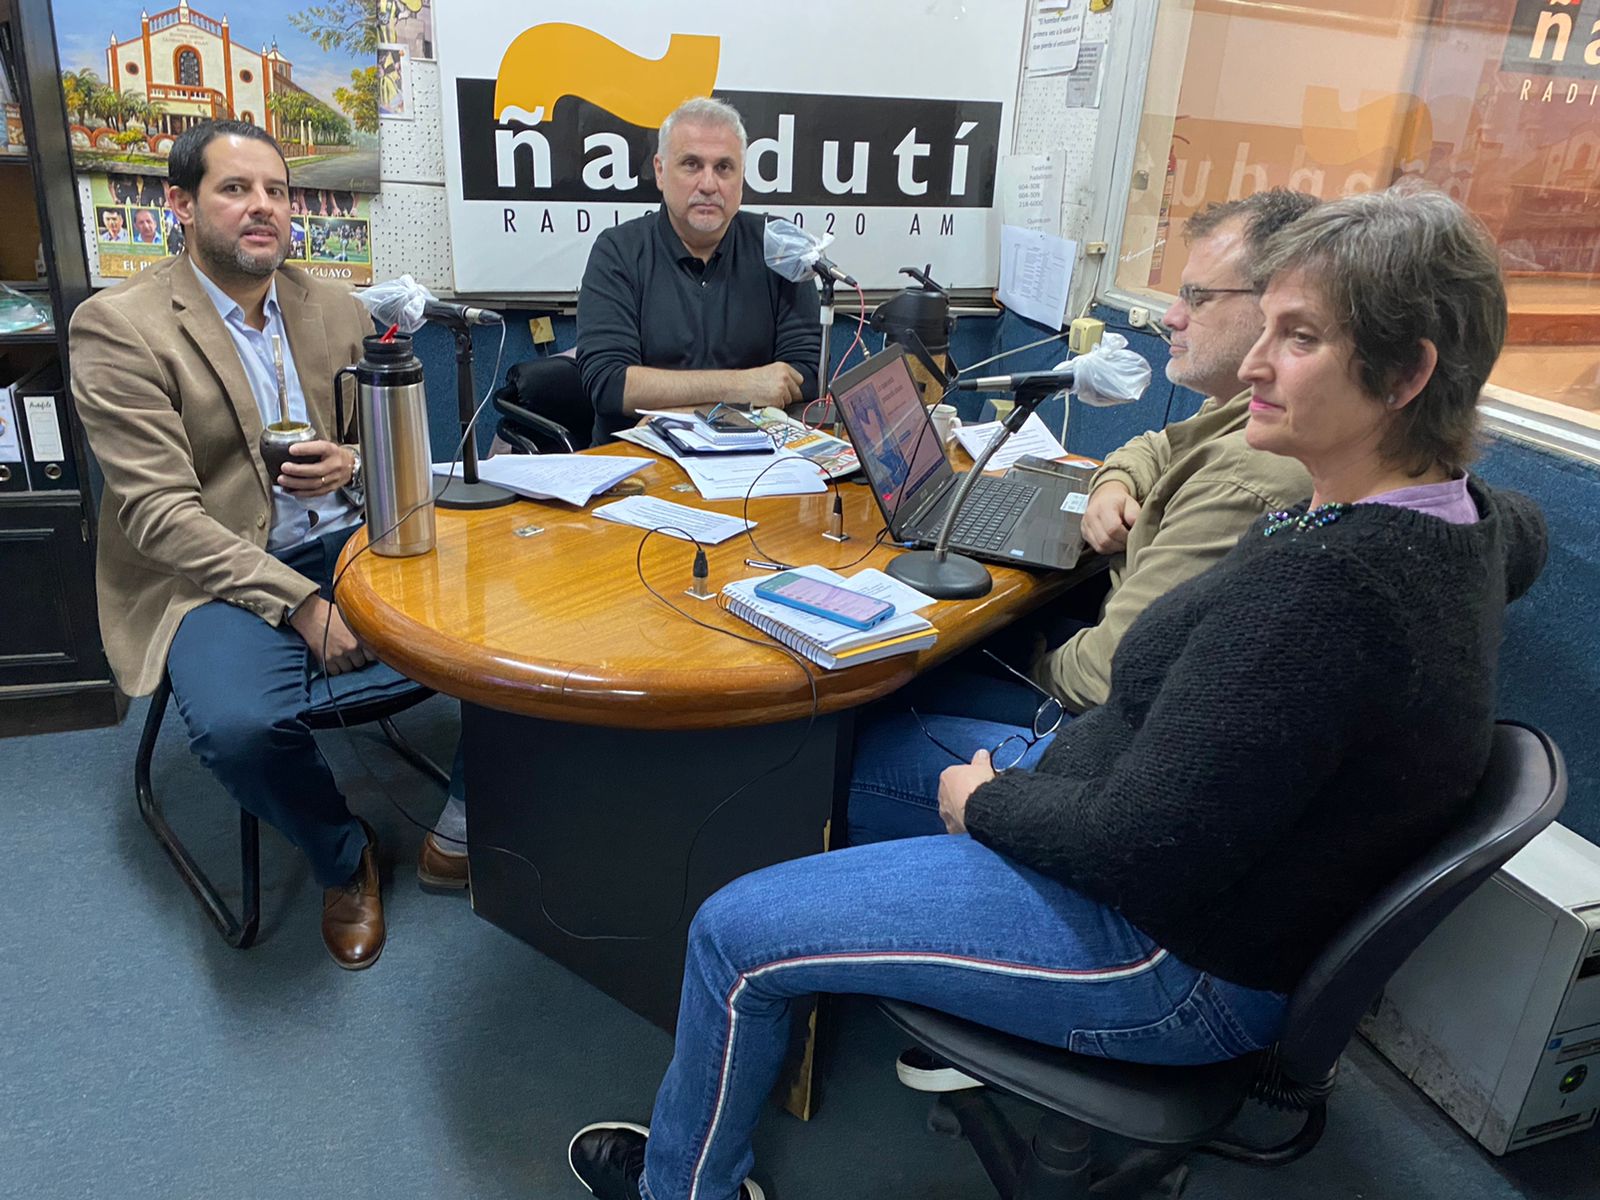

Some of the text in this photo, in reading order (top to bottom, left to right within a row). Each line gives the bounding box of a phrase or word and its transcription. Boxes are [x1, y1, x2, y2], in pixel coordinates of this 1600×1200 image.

[1528, 0, 1600, 66] ñ
[495, 105, 979, 196] ñadutí
[504, 208, 954, 236] RADI 020 AM
